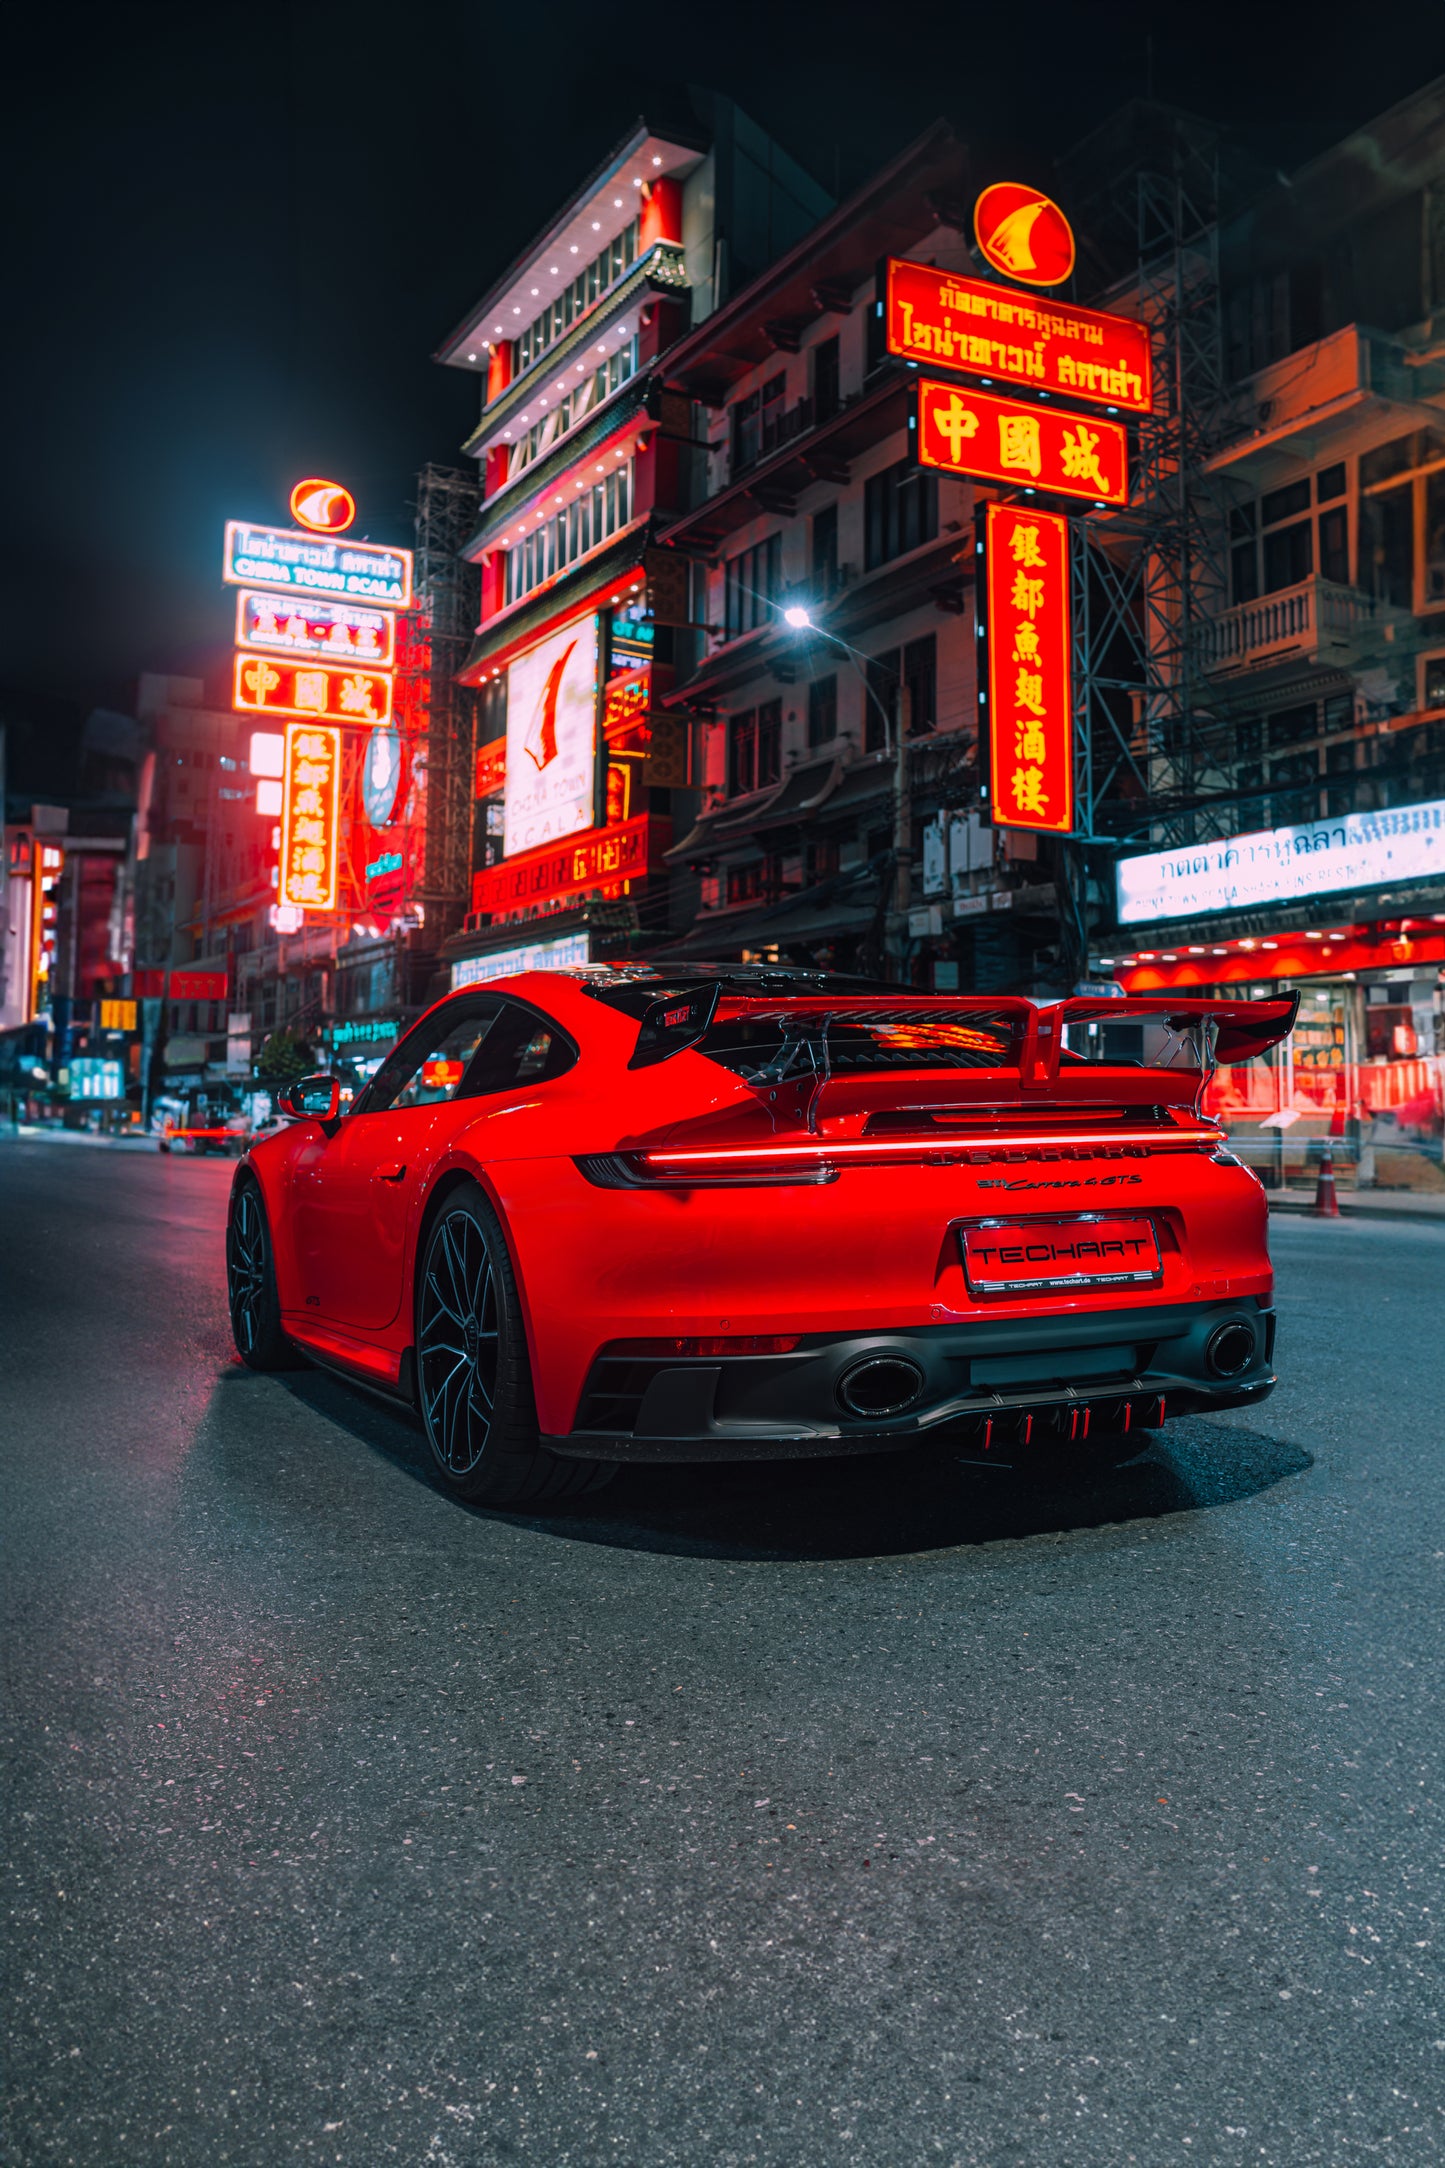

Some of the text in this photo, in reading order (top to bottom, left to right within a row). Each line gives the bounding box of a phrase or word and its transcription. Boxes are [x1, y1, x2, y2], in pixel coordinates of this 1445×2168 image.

[898, 300, 1143, 401] ไชน่าทาวน์ สกาล่า
[933, 394, 1110, 494] 中國城
[236, 558, 402, 598] CHINA TOWN SCALA
[1008, 523, 1050, 817] 銀都魚翅酒樓
[511, 808, 586, 850] SCALA
[931, 1145, 1152, 1165] TECHART
[1005, 1179, 1082, 1191] Carrera
[1084, 1177, 1098, 1186] 4
[1100, 1174, 1143, 1186] GTS
[971, 1238, 1148, 1266] TECHART
[1009, 1275, 1129, 1289] TECHART www.techart.de TECHART
